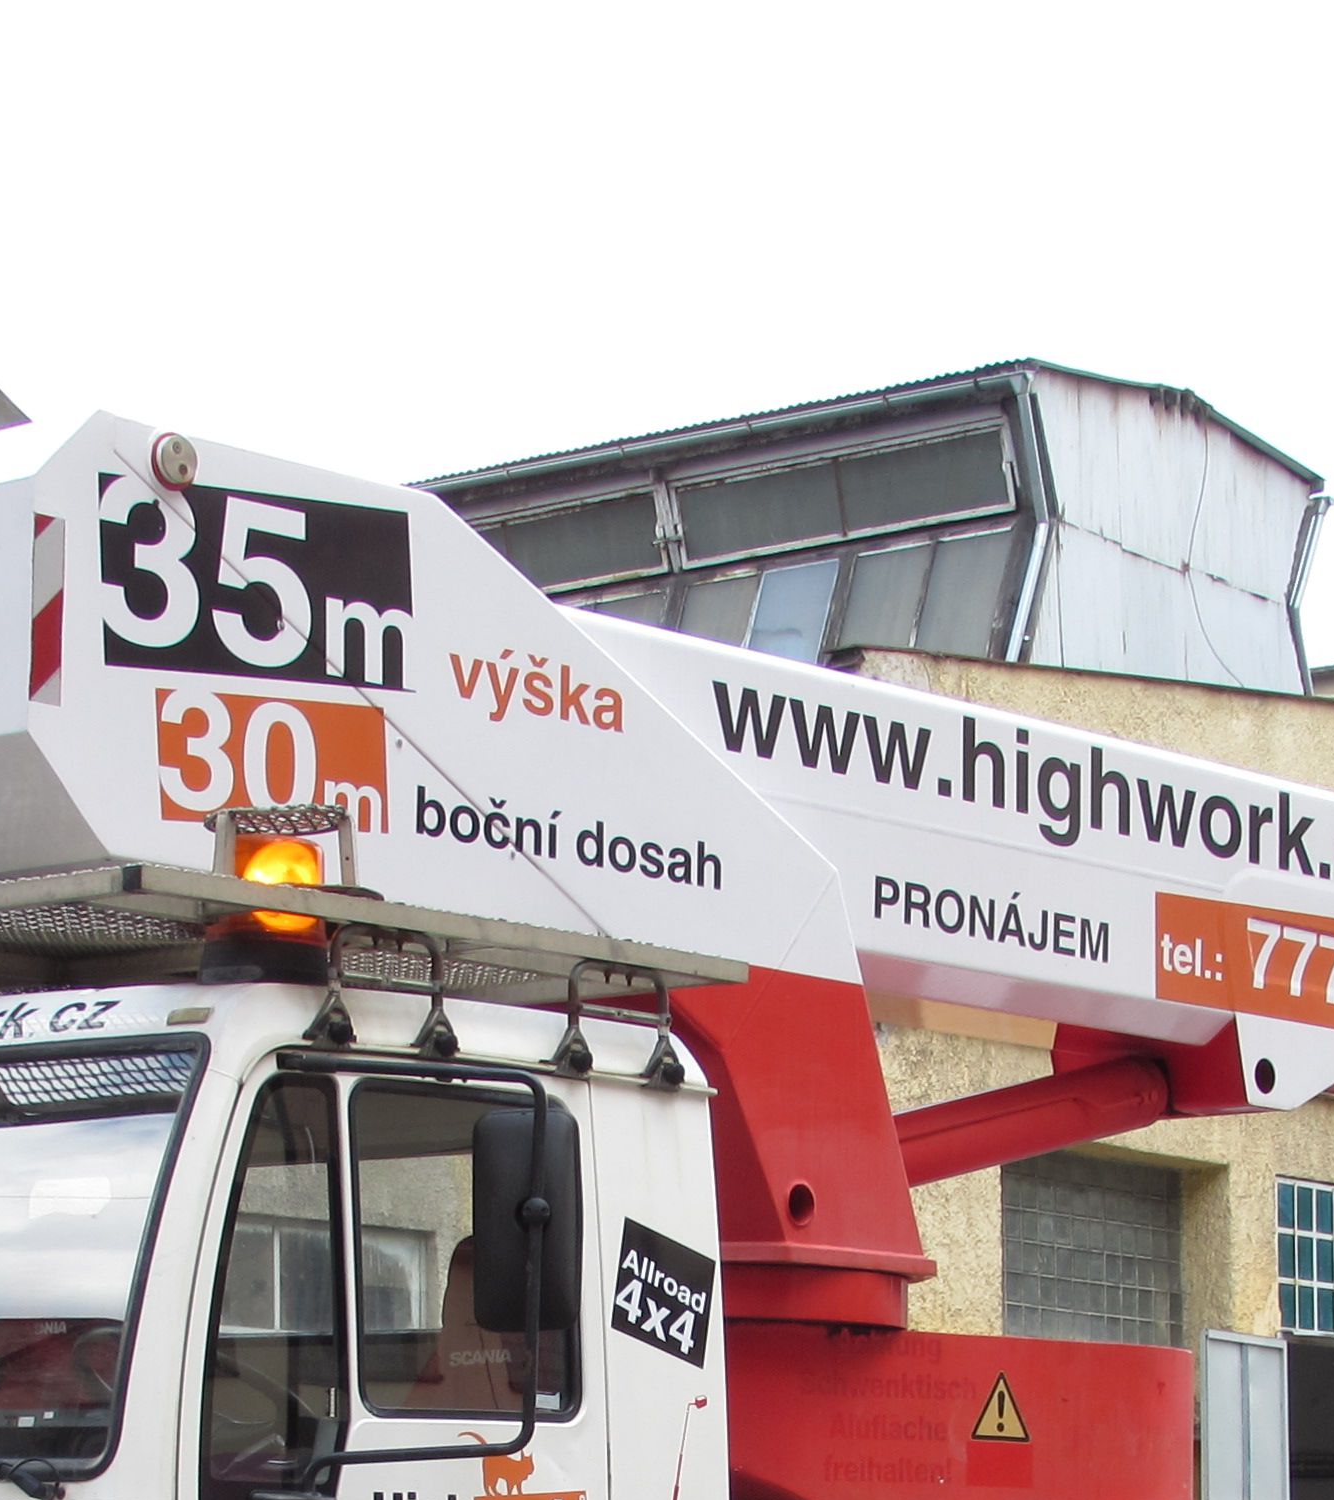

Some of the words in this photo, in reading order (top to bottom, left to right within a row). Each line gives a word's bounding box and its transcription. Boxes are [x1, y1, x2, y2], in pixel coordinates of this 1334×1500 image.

[99, 473, 414, 688] 35m
[449, 648, 624, 734] výška
[158, 688, 383, 833] 30m
[415, 785, 558, 860] boční
[575, 820, 723, 892] dosah
[873, 875, 1110, 965] PRONÁJEM
[1160, 931, 1224, 983] tel.:
[615, 1278, 697, 1356] 4x4
[621, 1247, 706, 1316] Allroad
